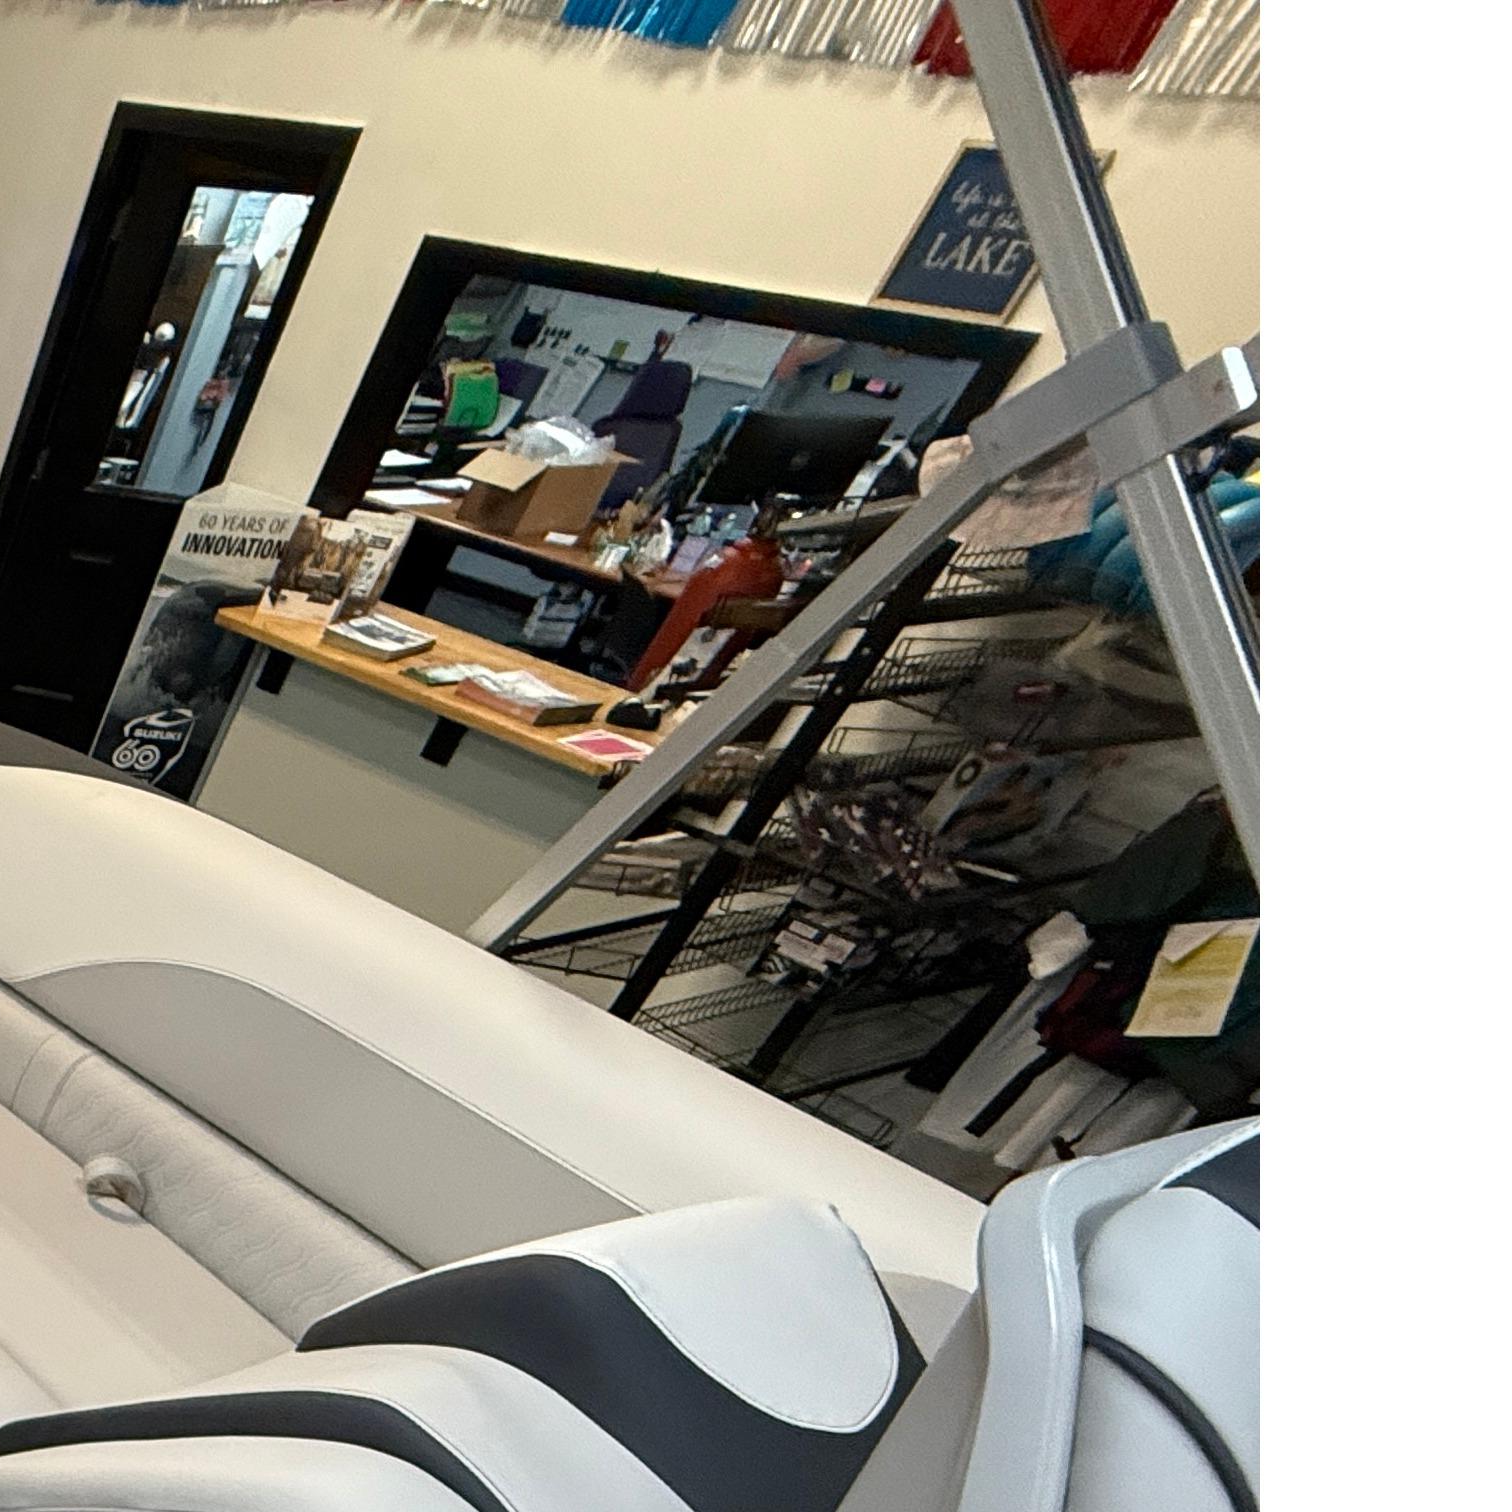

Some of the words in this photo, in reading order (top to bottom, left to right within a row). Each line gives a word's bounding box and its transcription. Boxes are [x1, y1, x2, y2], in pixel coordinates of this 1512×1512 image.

[925, 232, 1032, 275] LAKE
[198, 513, 219, 530] 60
[222, 514, 266, 533] YEARS
[269, 516, 291, 534] OF
[181, 531, 291, 560] INNOVATION
[112, 738, 161, 772] 60
